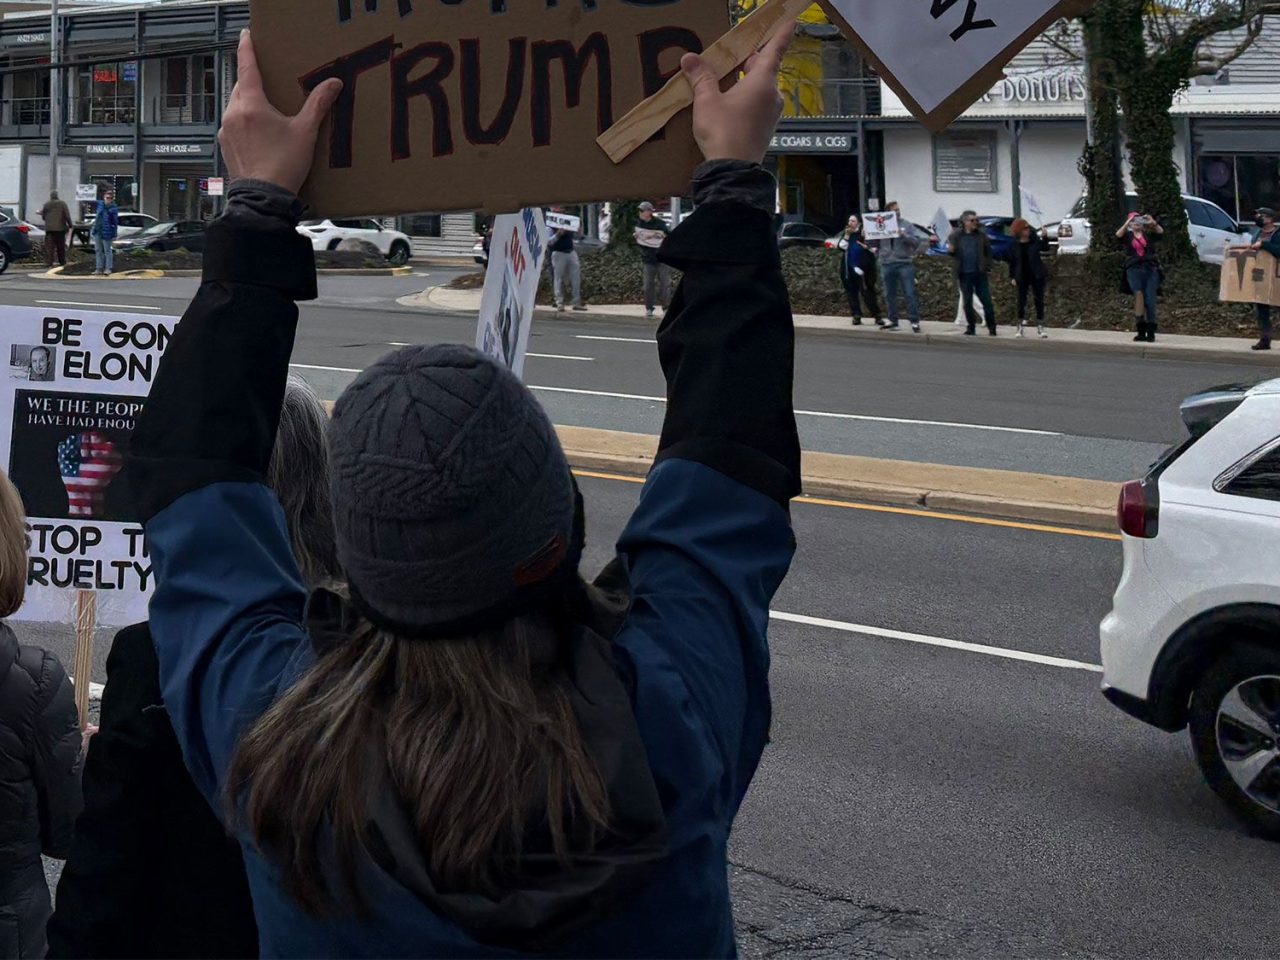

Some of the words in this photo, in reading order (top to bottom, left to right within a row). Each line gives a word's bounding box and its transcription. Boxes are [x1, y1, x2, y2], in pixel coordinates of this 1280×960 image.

[154, 144, 169, 153] SUSHI
[170, 144, 188, 153] HOUSE
[780, 136, 812, 147] CIGARS
[815, 136, 822, 147] &
[825, 136, 848, 147] CIGS
[42, 316, 83, 347] BE
[103, 320, 178, 352] GON
[63, 350, 153, 382] ELON
[27, 397, 52, 412] WE
[57, 398, 91, 414] THE
[28, 413, 64, 426] HAVE
[66, 416, 94, 428] HAD
